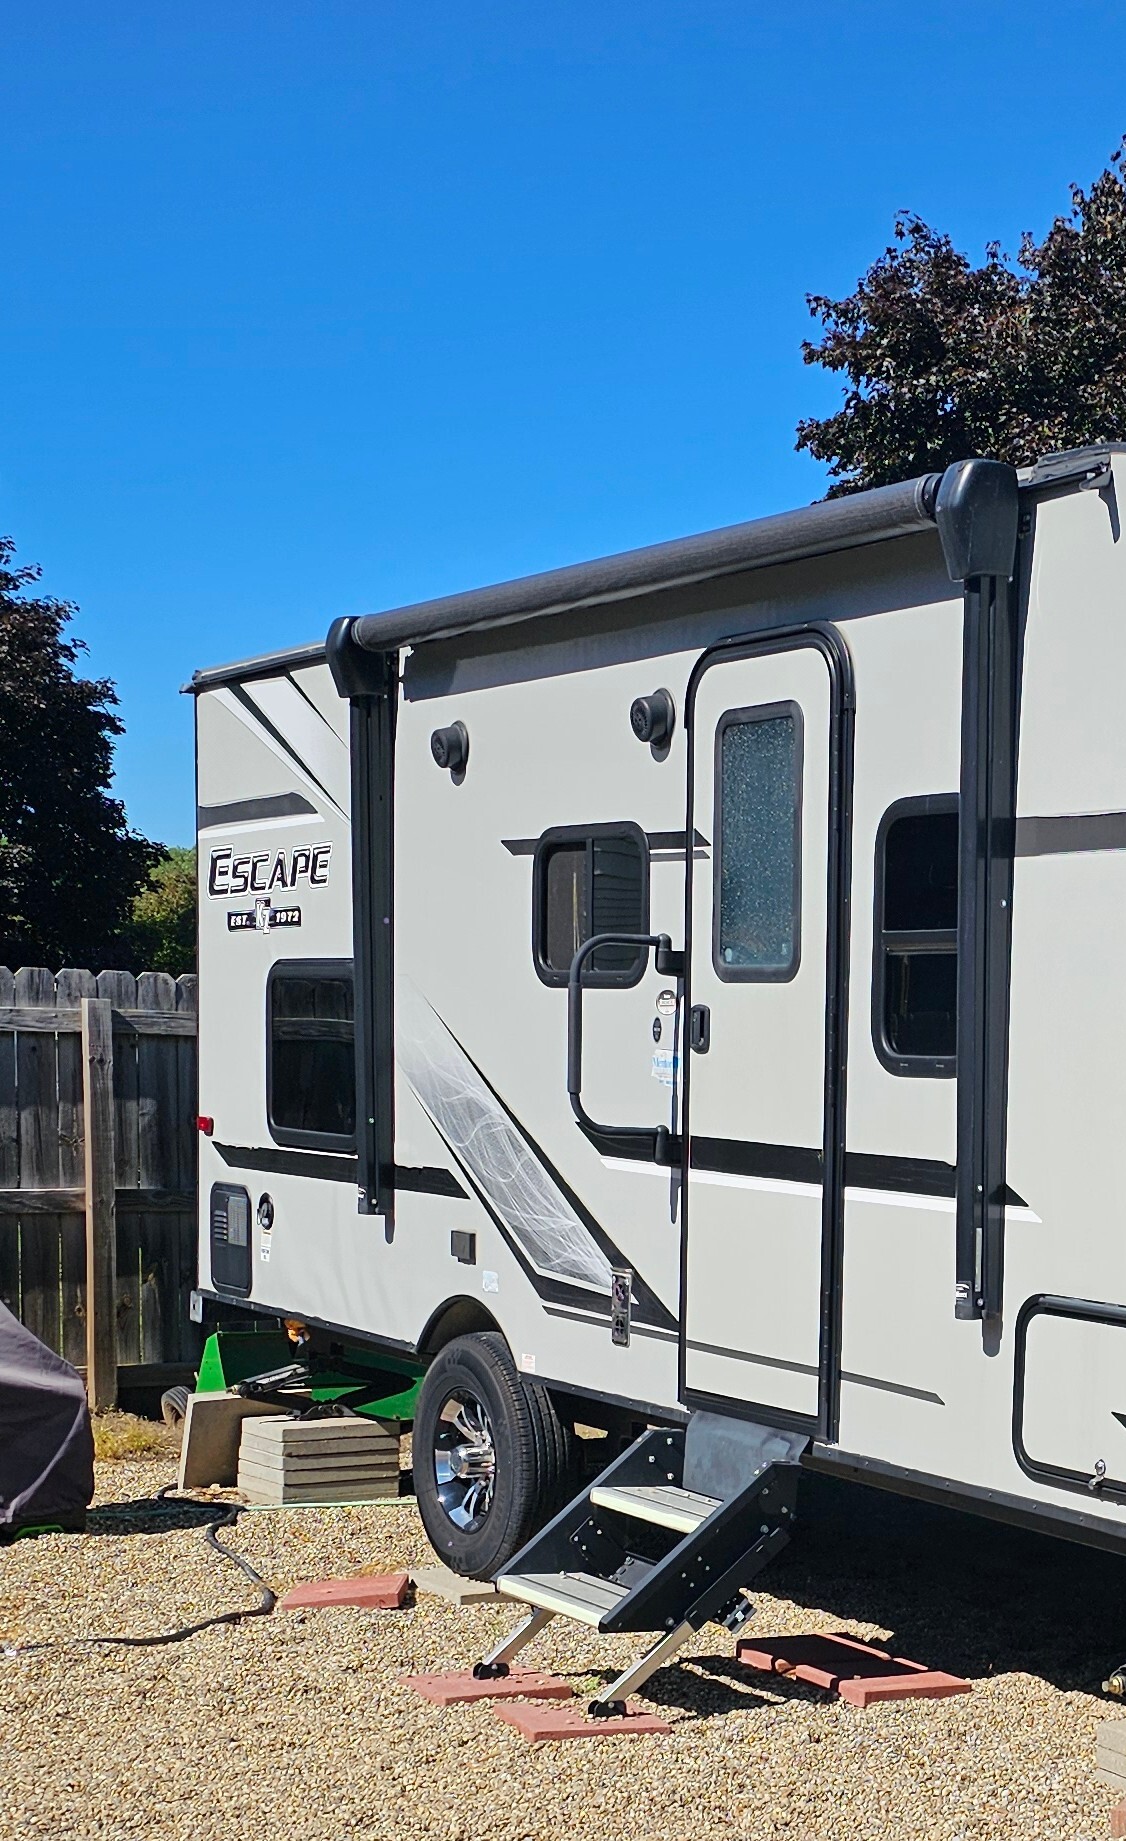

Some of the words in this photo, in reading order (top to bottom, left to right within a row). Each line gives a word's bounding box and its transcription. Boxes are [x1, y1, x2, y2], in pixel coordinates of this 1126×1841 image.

[208, 842, 332, 898] ESCAPE
[230, 914, 251, 927] EST.
[275, 910, 300, 923] 1972
